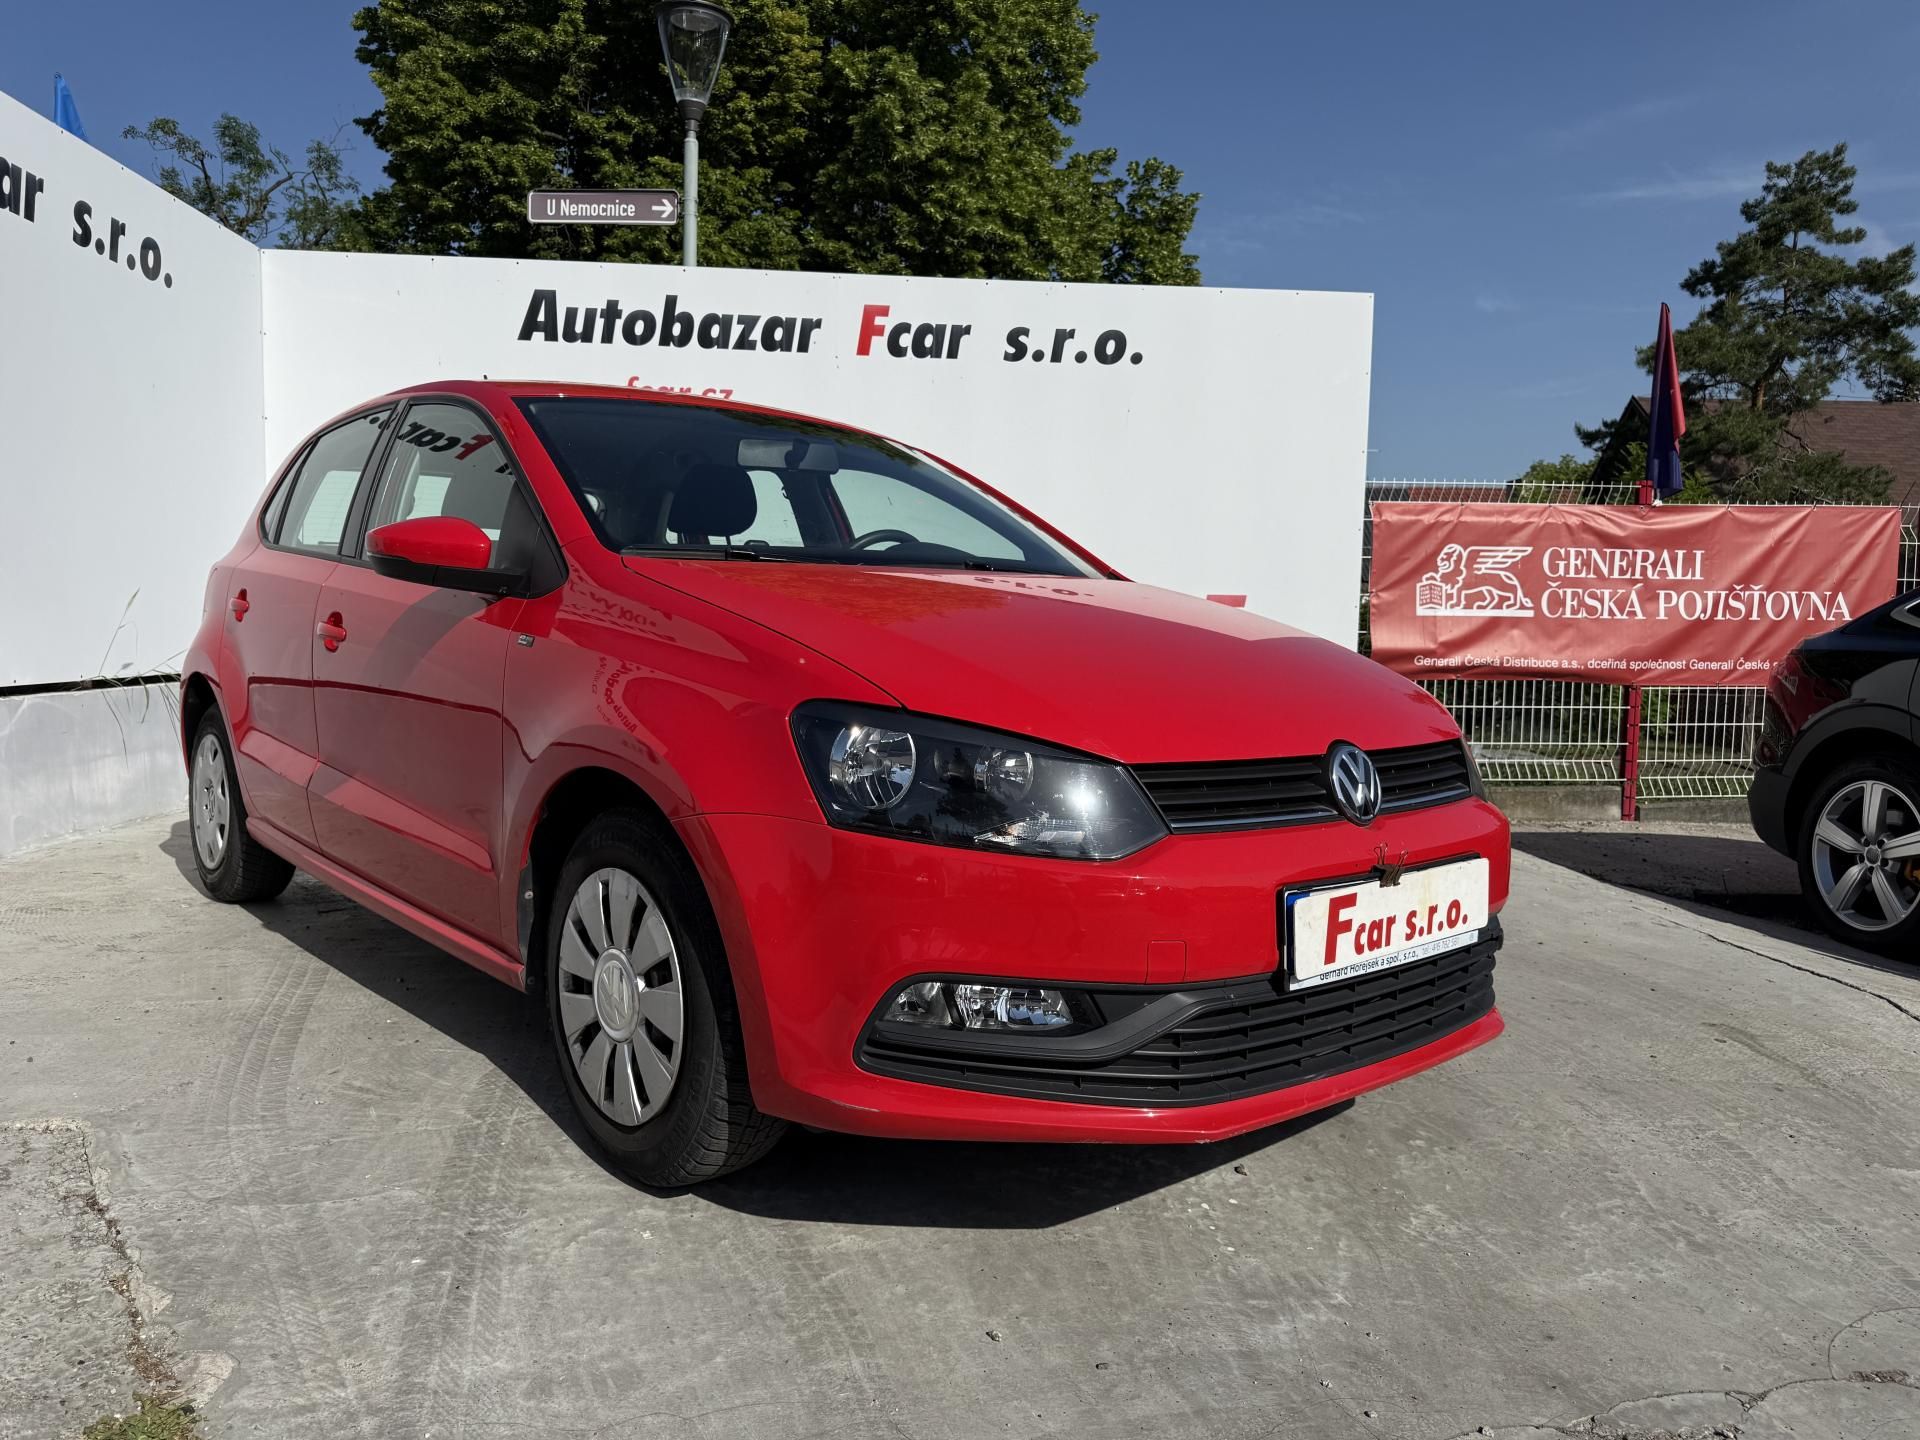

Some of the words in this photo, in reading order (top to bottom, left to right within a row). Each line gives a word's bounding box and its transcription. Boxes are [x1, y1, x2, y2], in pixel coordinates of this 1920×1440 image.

[546, 199, 556, 216] U
[560, 199, 636, 217] Nemocnice
[72, 199, 173, 289] s.r.o.
[517, 288, 822, 354] Autobazar
[856, 304, 971, 360] Fcar
[1003, 325, 1144, 366] s.r.o.
[1542, 547, 1704, 580] GENERALI
[1541, 581, 1646, 619] ČESKÁ
[1656, 584, 1852, 621] POJIŠŤOVNA
[1414, 655, 1460, 666] Generali
[1465, 654, 1499, 666] Česká
[1503, 656, 1557, 668] Distribuce
[1561, 658, 1584, 670] a.s.,
[1587, 658, 1627, 670] dceřiná
[1629, 658, 1687, 672] společnost
[1689, 658, 1734, 671] Generali
[1736, 656, 1770, 671] České
[1323, 892, 1396, 966] Fcar
[1405, 899, 1468, 942] s.r.o.
